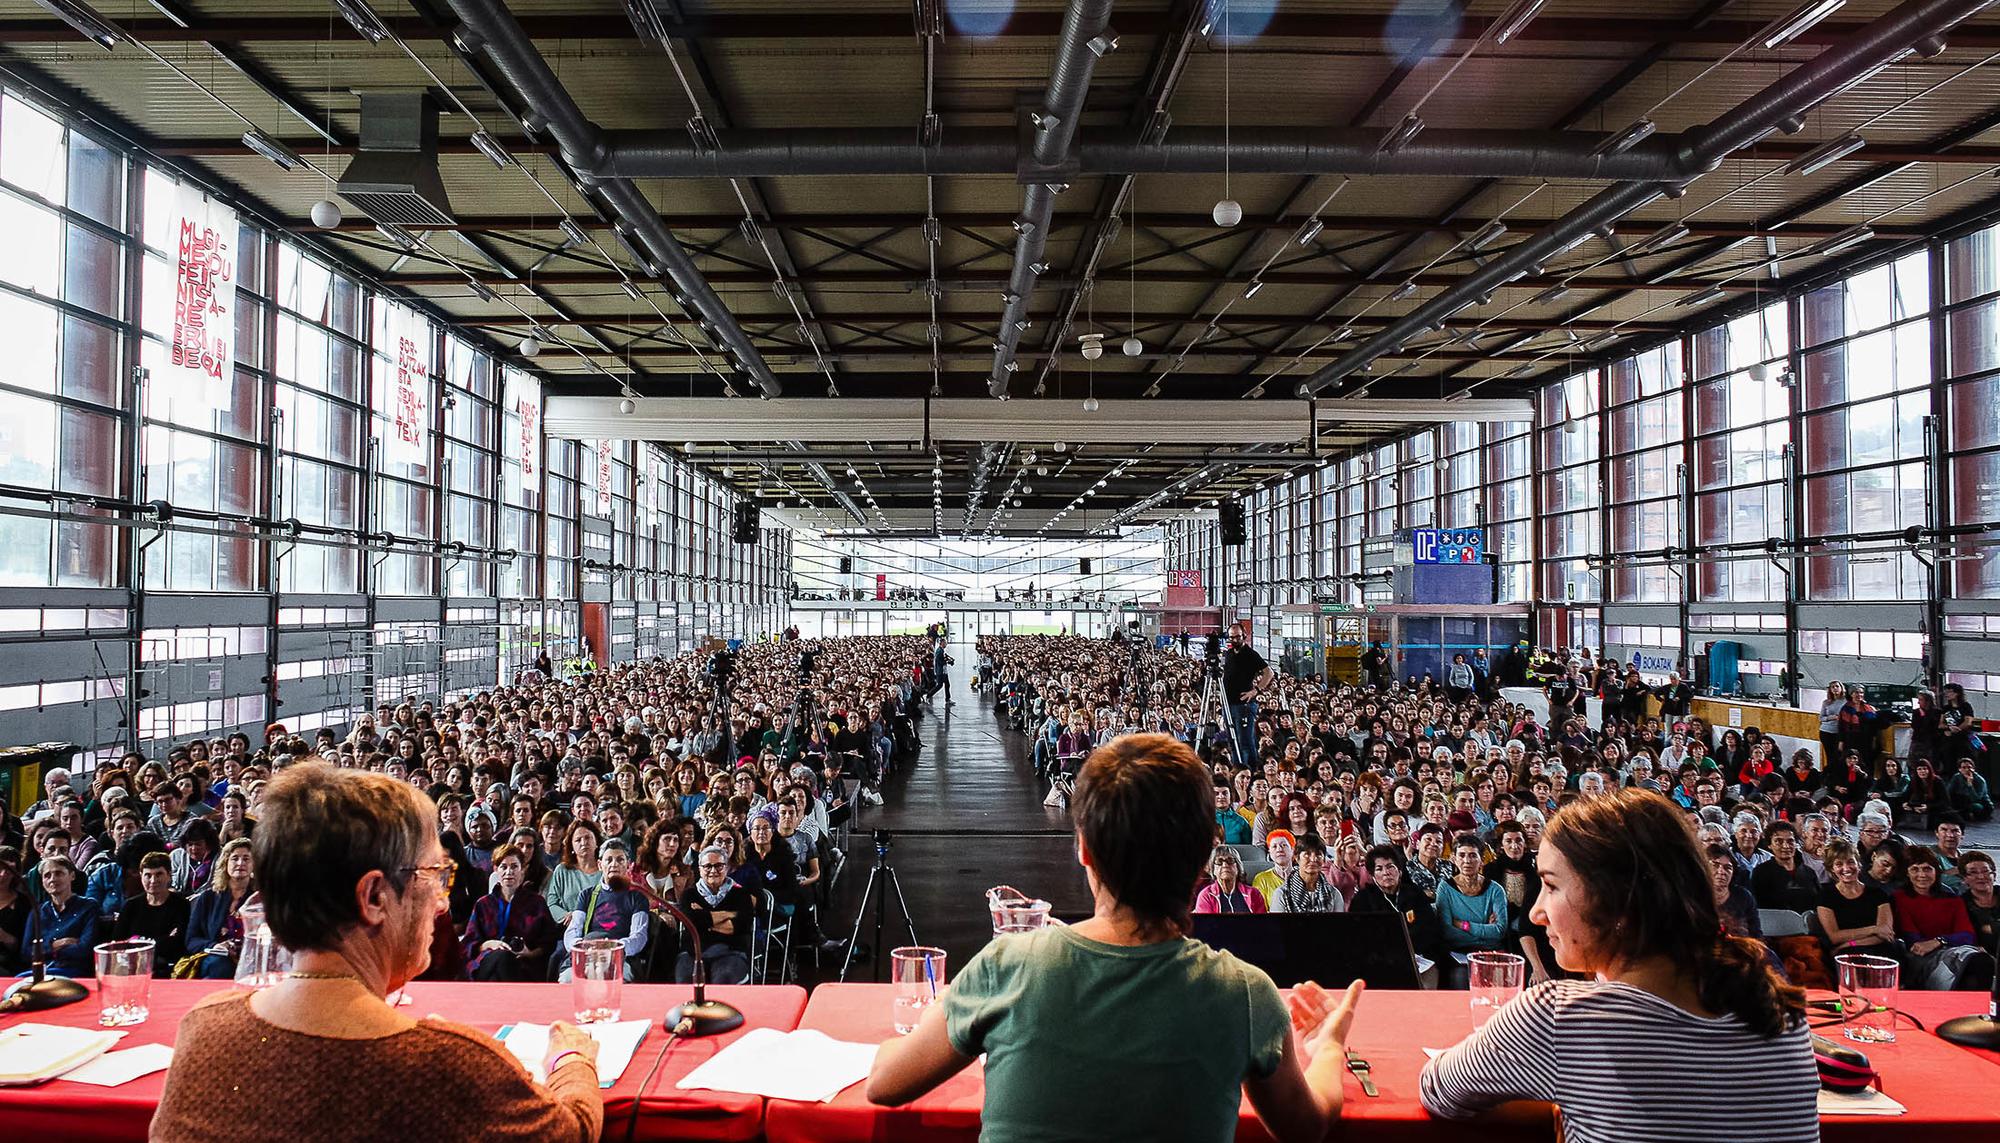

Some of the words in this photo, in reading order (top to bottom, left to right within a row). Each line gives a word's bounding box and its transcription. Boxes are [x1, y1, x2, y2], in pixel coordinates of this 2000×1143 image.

[398, 367, 412, 386] ETA
[1417, 531, 1437, 561] 02
[1168, 571, 1179, 586] 03
[1643, 656, 1673, 671] BOKATAK
